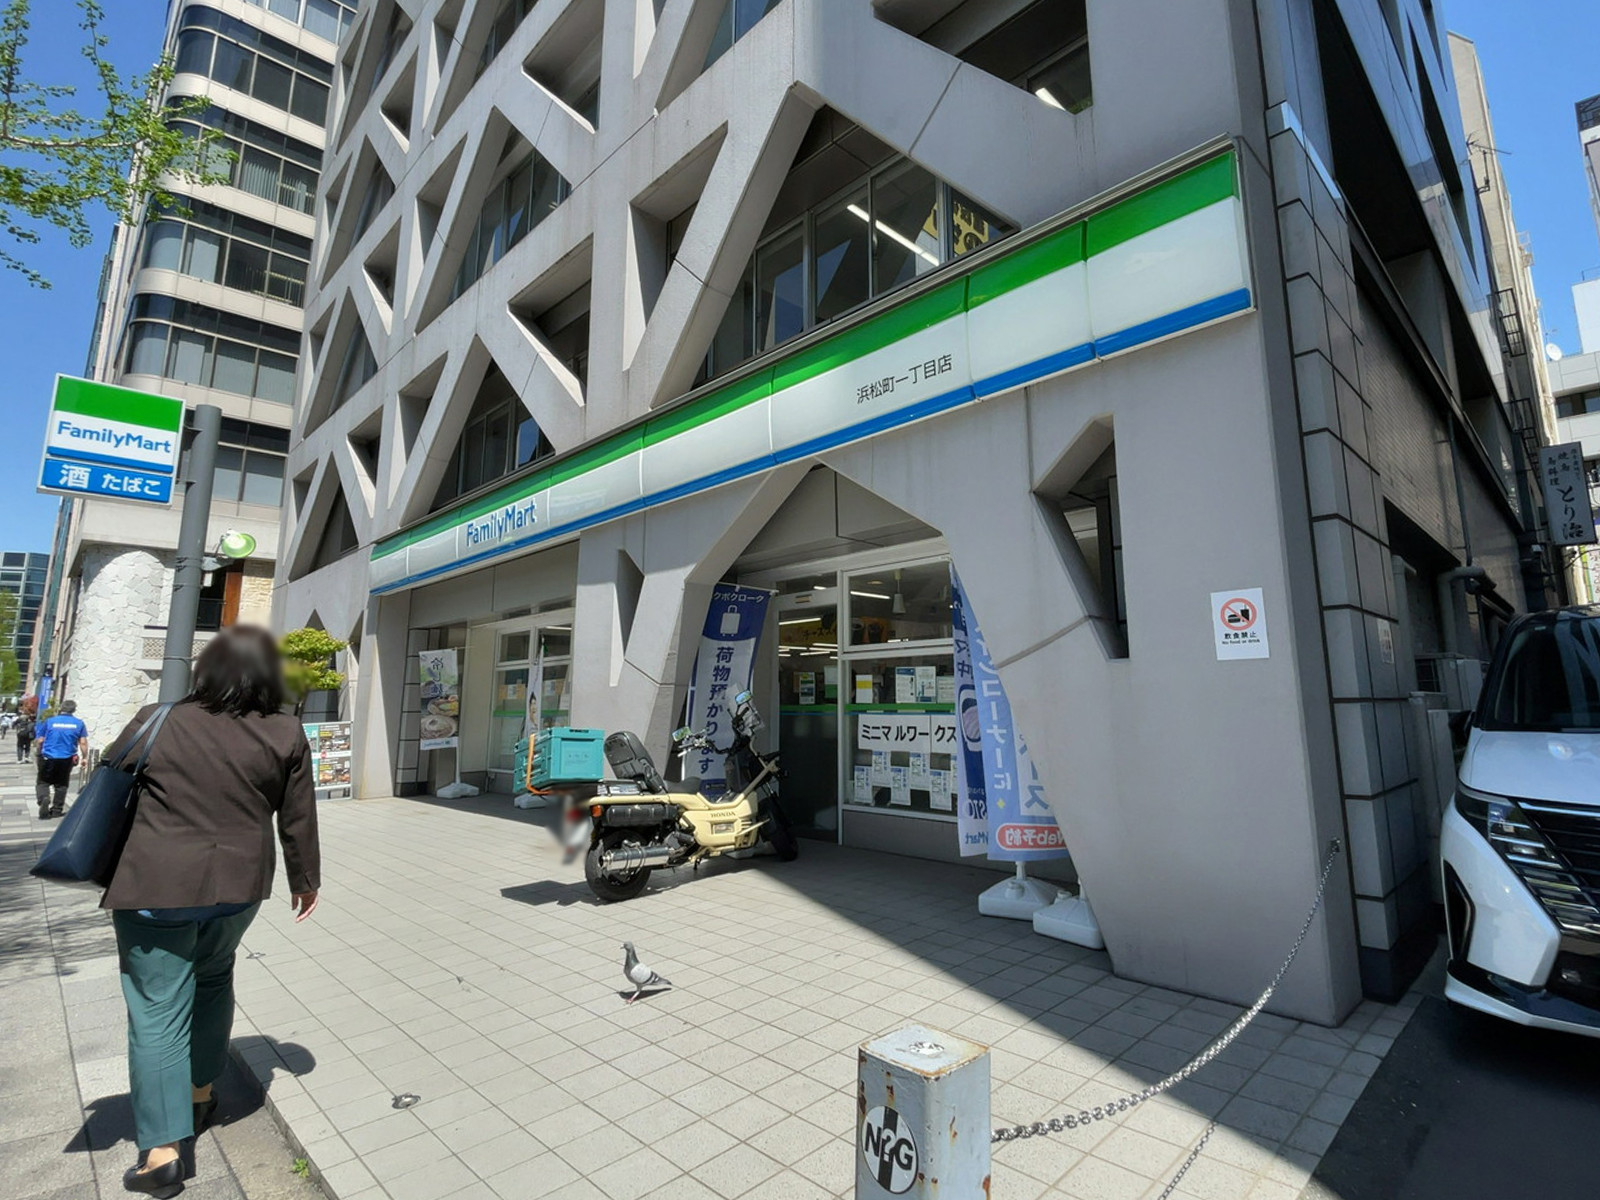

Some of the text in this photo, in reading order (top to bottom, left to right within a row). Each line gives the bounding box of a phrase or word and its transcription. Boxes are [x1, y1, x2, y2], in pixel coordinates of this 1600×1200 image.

[857, 354, 952, 404] 浜松町一丁目店
[57, 420, 171, 453] FamilyMart
[59, 464, 161, 496] 酒 たばこ
[466, 500, 536, 547] FamilyMart
[861, 724, 957, 744] ミニマルワークス
